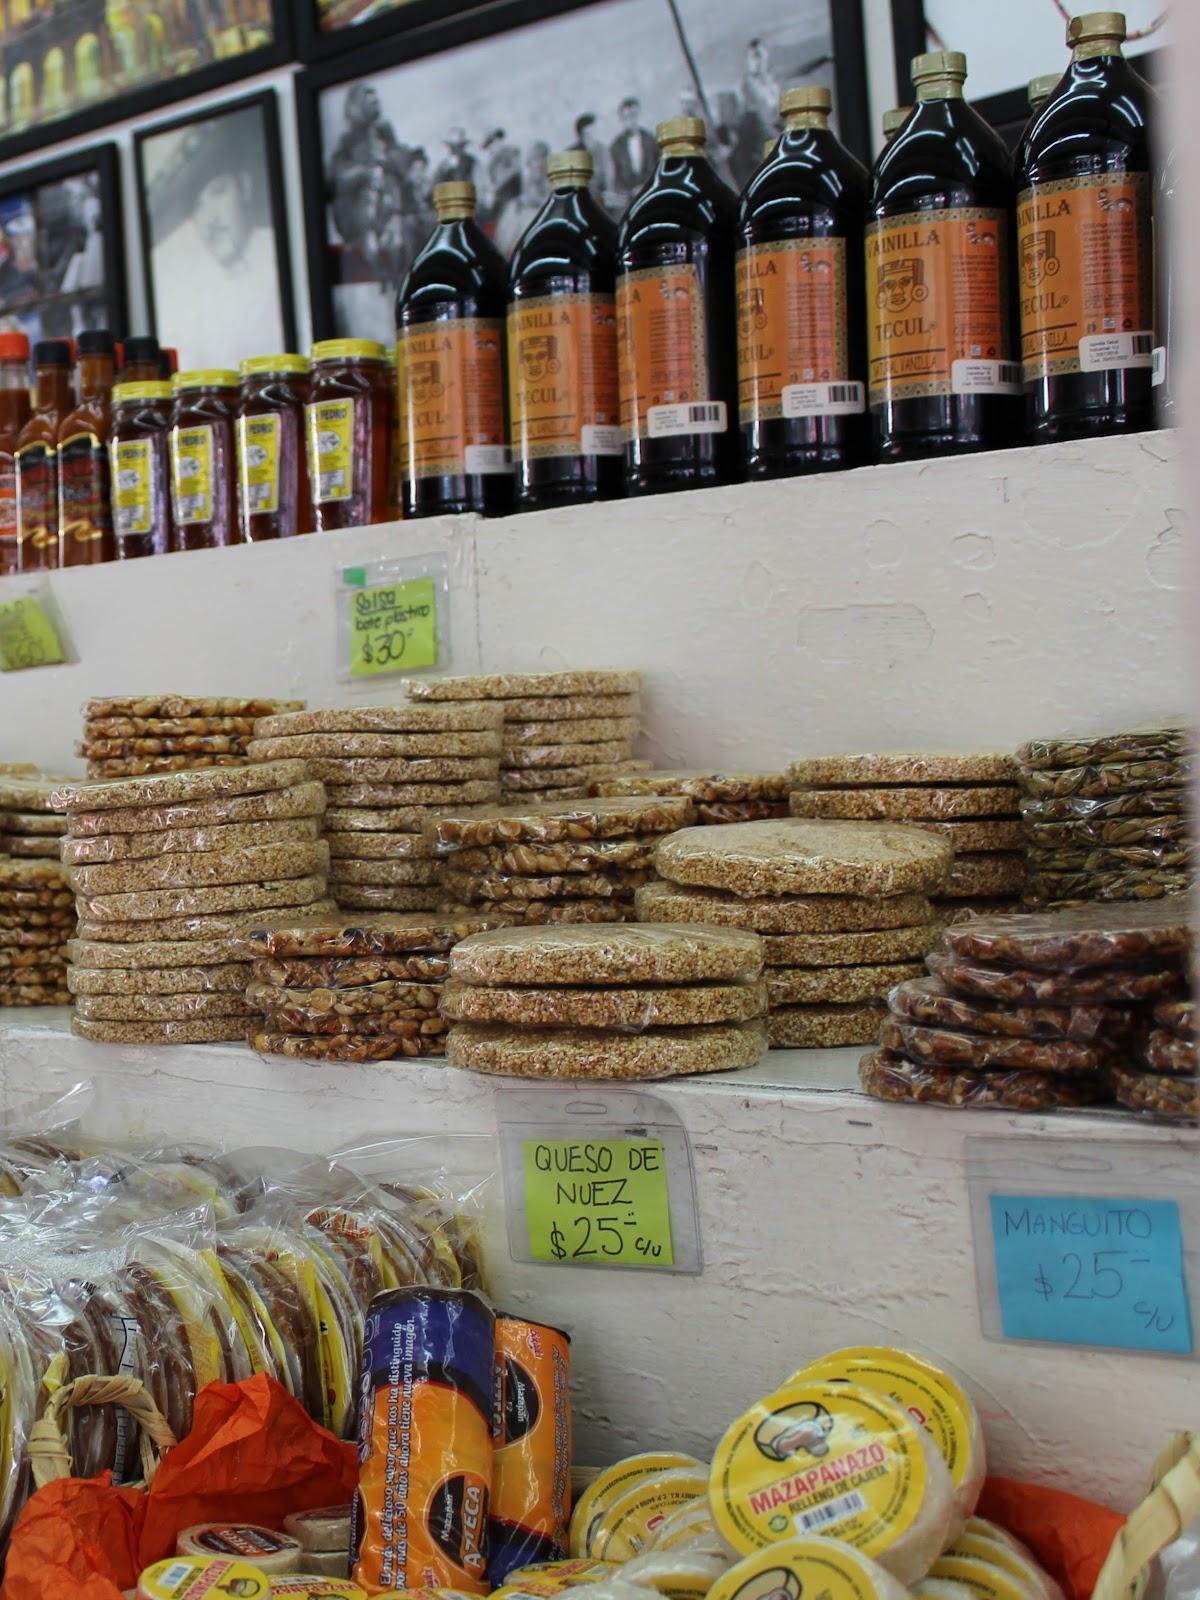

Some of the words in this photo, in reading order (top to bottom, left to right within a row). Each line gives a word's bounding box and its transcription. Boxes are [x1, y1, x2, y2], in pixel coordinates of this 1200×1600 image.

[535, 1144, 613, 1173] QUESO
[628, 1147, 660, 1171] DE
[556, 1178, 633, 1206] NUEZ
[1004, 1207, 1152, 1239] MANGUITO
[388, 1322, 404, 1385] distinguido
[387, 1387, 399, 1403] ha
[401, 1363, 414, 1398] nueva
[388, 1405, 398, 1426] nos
[399, 1401, 412, 1429] tiene
[387, 1428, 399, 1451] que
[397, 1432, 411, 1467] ahora
[395, 1470, 409, 1498] años
[749, 1442, 887, 1515] MAZAPANAZO
[789, 1487, 836, 1515] RELLENO
[837, 1481, 851, 1496] DE
[851, 1466, 889, 1490] CAJETA
[381, 1488, 395, 1541] delicioso
[394, 1503, 408, 1519] 50
[395, 1522, 407, 1538] de
[463, 1486, 482, 1569] AZTECA
